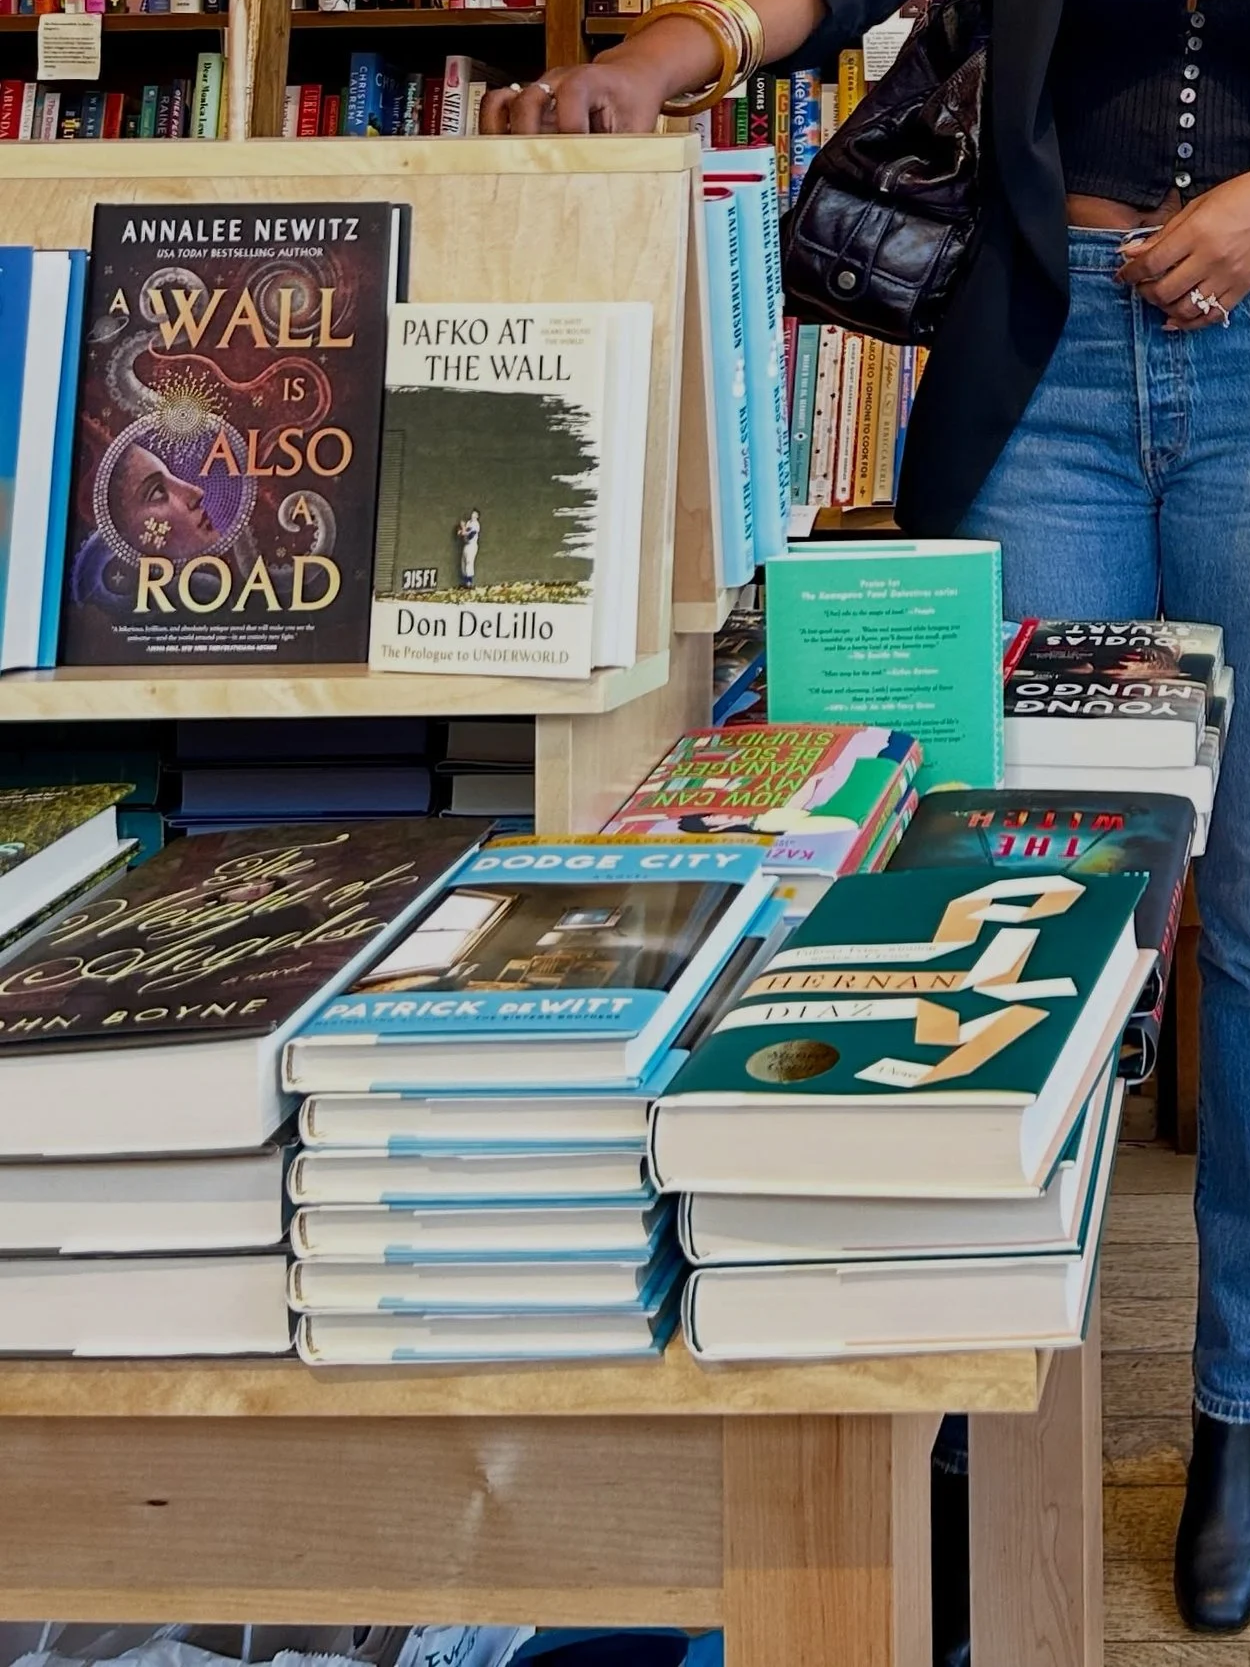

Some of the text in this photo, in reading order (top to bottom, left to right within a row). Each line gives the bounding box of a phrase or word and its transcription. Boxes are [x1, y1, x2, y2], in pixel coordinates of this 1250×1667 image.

[121, 218, 360, 244] ANNALEE NEWITZ
[156, 247, 324, 259] USA TODAY BESTSELLING AUTHOR
[109, 286, 356, 351] A WALL
[402, 318, 489, 347] PAFKO
[498, 318, 535, 345] AT
[425, 354, 572, 382] THE WALL
[282, 377, 306, 402] IS
[199, 426, 354, 478] ALSO
[291, 495, 313, 526] A
[132, 554, 342, 614] ROAD
[396, 608, 554, 641] Don DeLillo
[381, 644, 570, 665] The Prologue to UNDERWORLD
[1015, 683, 1193, 699] MUNGO
[1013, 700, 1179, 716] YOUNG
[784, 747, 825, 762] BE
[671, 761, 814, 777] MANAGER
[652, 791, 794, 808] HOW CAN
[967, 810, 1126, 830] WITCH
[993, 834, 1086, 858] THE
[203, 834, 350, 888] The
[471, 853, 742, 872] DODGE CITY
[47, 878, 332, 947] Weight
[766, 974, 958, 991] HERNAN
[103, 998, 269, 1026] BOYNE
[322, 1000, 487, 1020] PATRICK
[765, 1003, 874, 1020] DIAZ
